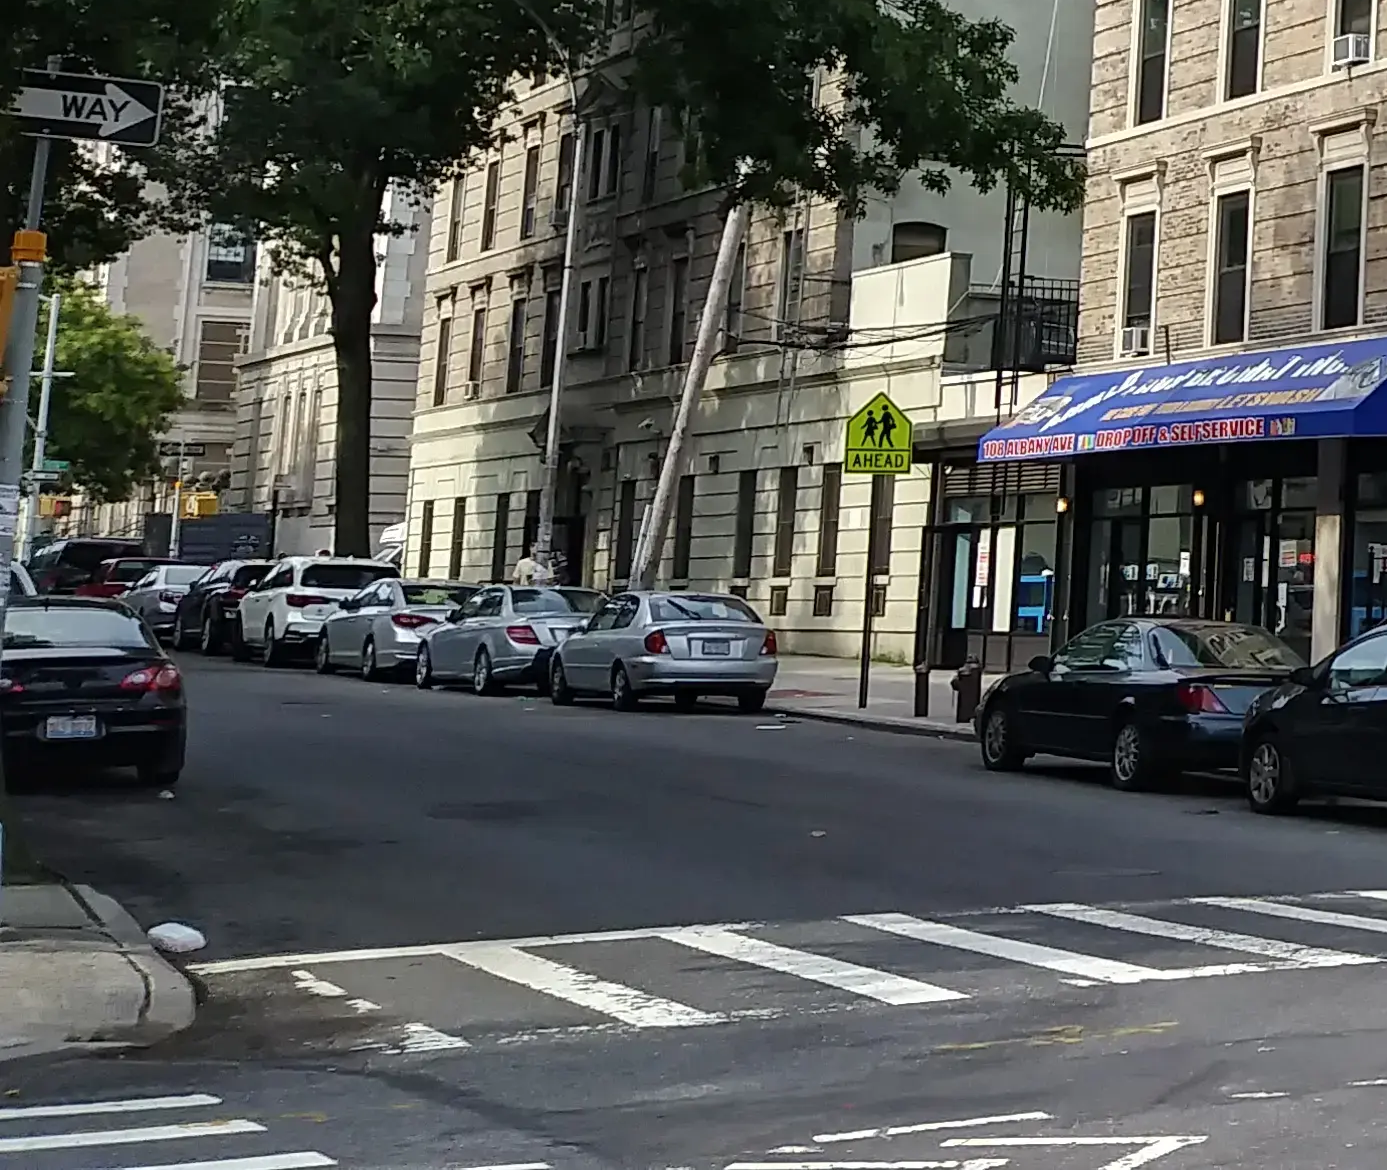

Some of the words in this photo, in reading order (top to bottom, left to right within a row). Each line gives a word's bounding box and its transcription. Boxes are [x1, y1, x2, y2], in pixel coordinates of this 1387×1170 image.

[62, 94, 132, 122] WAY
[984, 440, 1005, 458] 108
[1158, 427, 1170, 443] &
[852, 453, 904, 468] AHEAD
